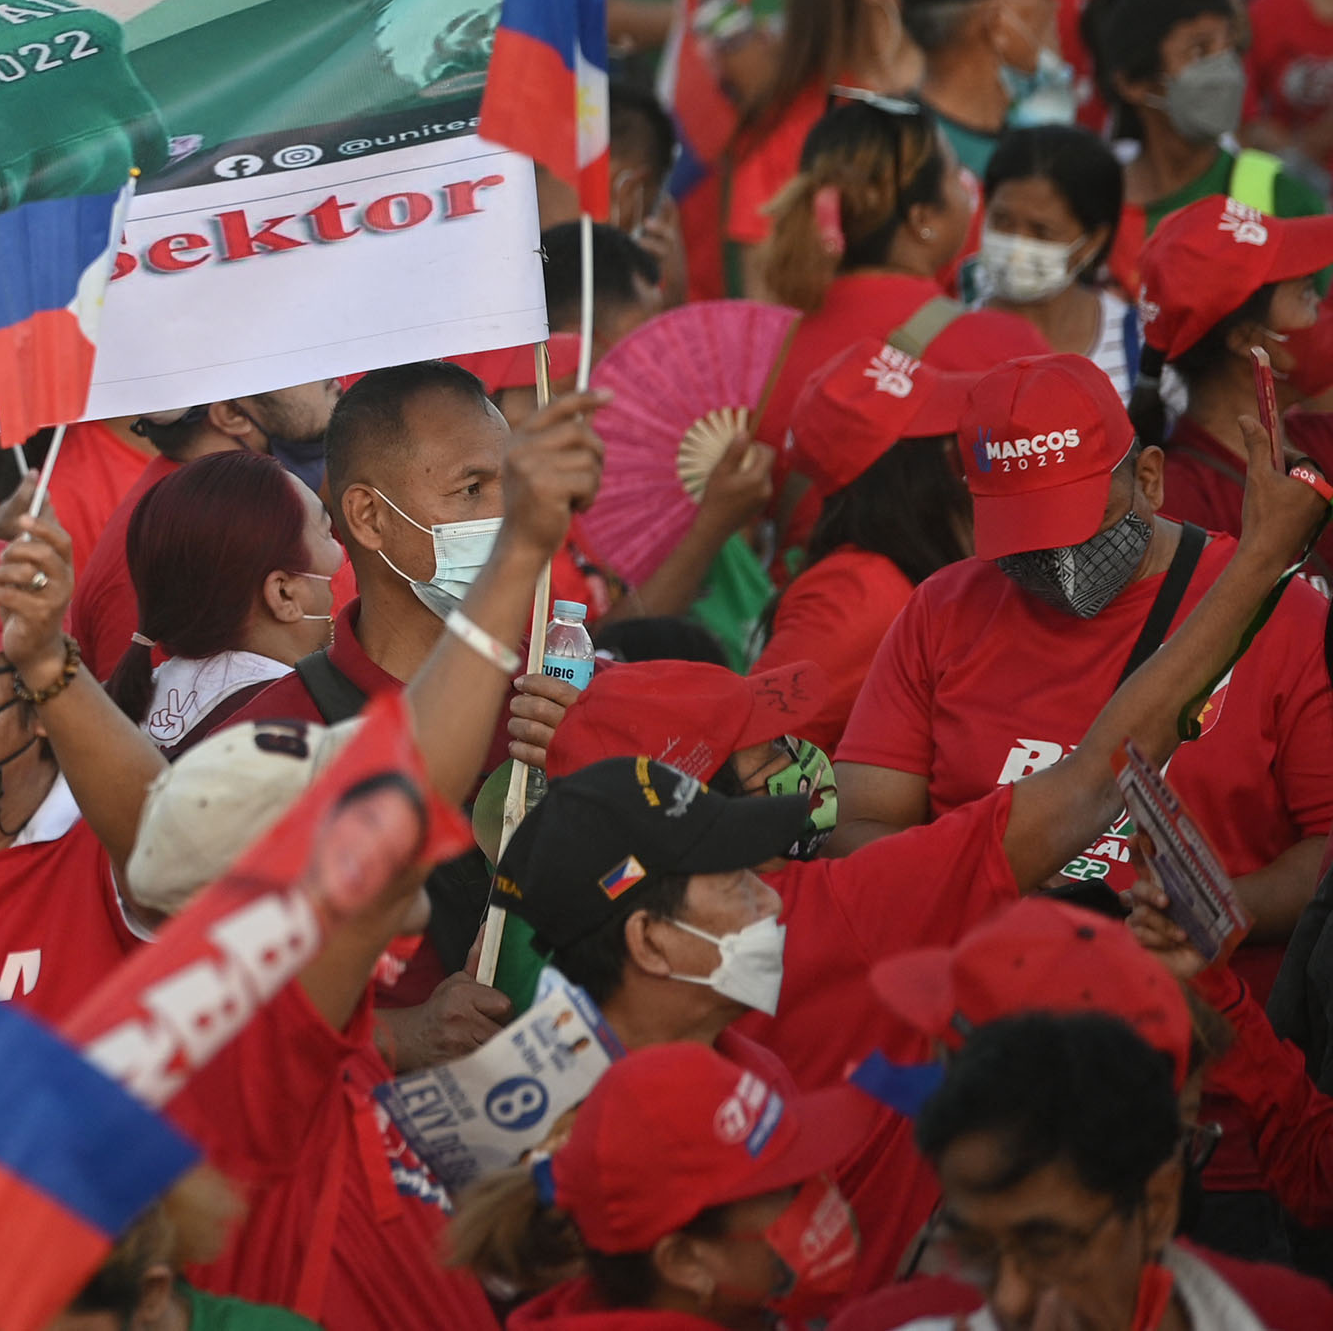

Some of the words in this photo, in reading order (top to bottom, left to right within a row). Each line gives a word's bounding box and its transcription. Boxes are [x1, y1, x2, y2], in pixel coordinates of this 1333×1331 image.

[985, 429, 1081, 460] MARCOS
[1002, 450, 1066, 473] 2022
[488, 1082, 546, 1129] 8
